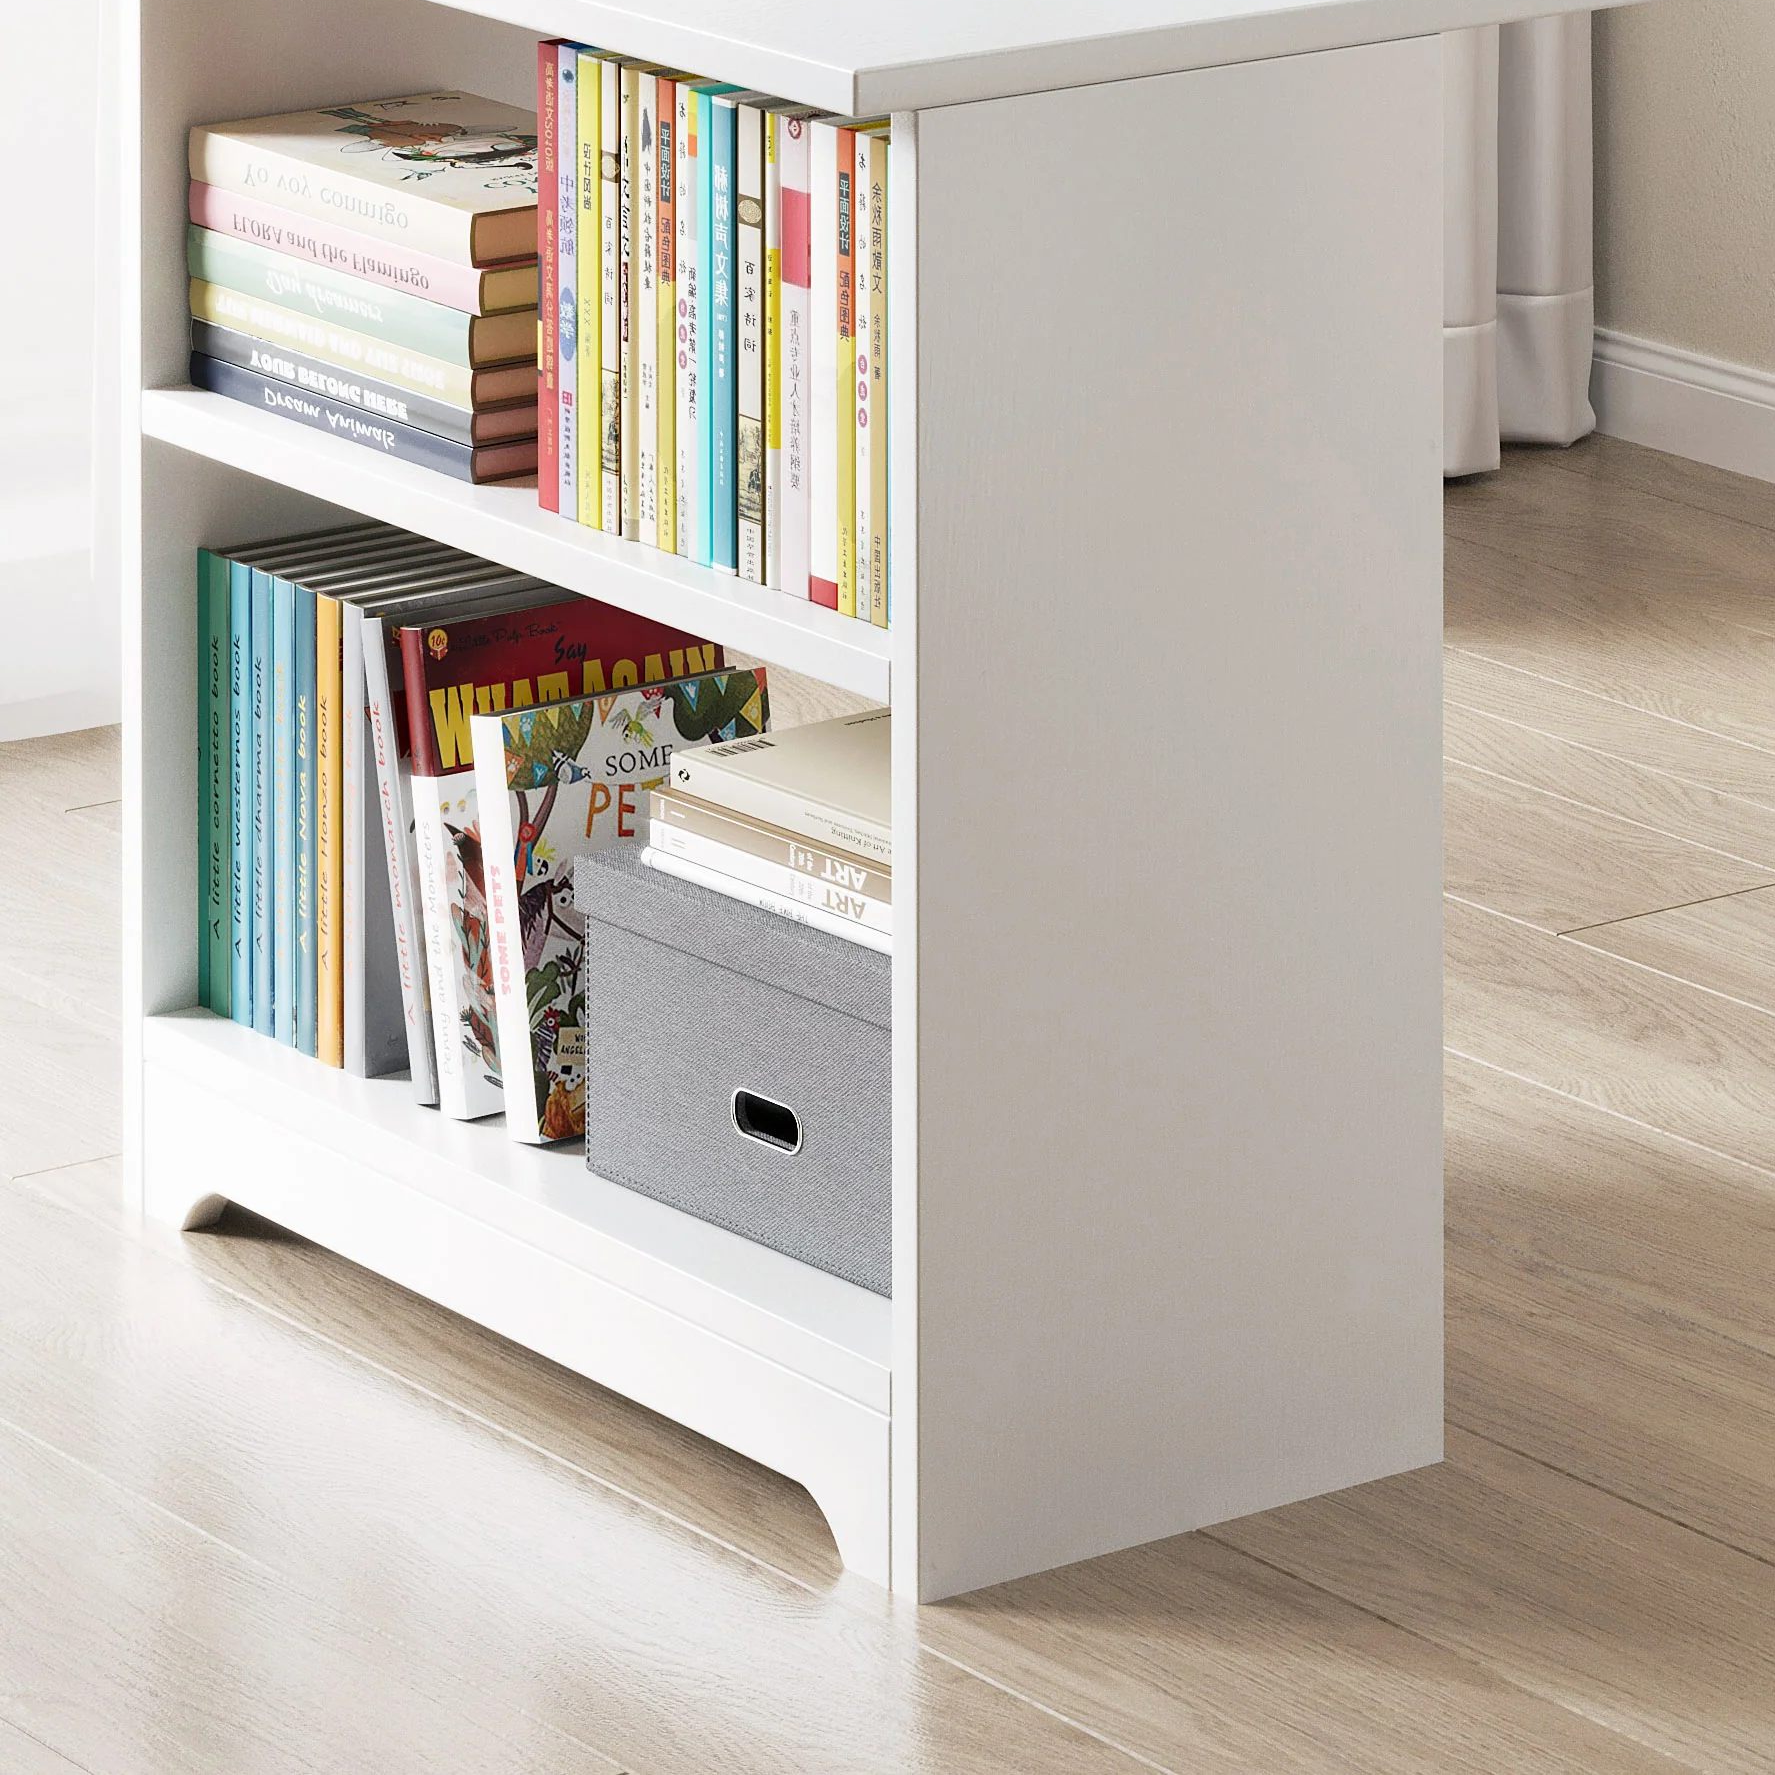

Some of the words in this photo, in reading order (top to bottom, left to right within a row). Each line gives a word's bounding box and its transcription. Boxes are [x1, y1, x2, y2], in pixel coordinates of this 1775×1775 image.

[211, 636, 219, 705] book
[555, 635, 587, 665] Say
[254, 656, 262, 719] book
[298, 695, 306, 759] book
[319, 695, 328, 758] book
[373, 701, 387, 766] book
[211, 711, 220, 829] cornetto
[254, 733, 263, 842] dharma
[605, 744, 673, 777] SOME
[298, 772, 306, 840] Nova
[383, 781, 403, 909] monarch
[420, 819, 441, 913] Monsters
[830, 828, 862, 846] Knitting
[863, 840, 872, 849] of
[872, 842, 886, 854] Art
[211, 842, 220, 905] little
[233, 860, 242, 924] little
[254, 856, 263, 919] little
[298, 853, 307, 918] little
[319, 872, 328, 936] little
[490, 864, 506, 921] PETS
[821, 857, 868, 890] ART
[821, 888, 867, 920] ART
[212, 918, 220, 940] A
[235, 938, 241, 959] A
[256, 936, 263, 954] A
[299, 932, 306, 952] A
[398, 921, 413, 988] little
[431, 918, 443, 953] the
[320, 950, 328, 970] A
[435, 963, 447, 1009] and
[499, 931, 512, 996] SOME
[408, 1003, 416, 1026] A
[441, 1019, 454, 1078] Penny
